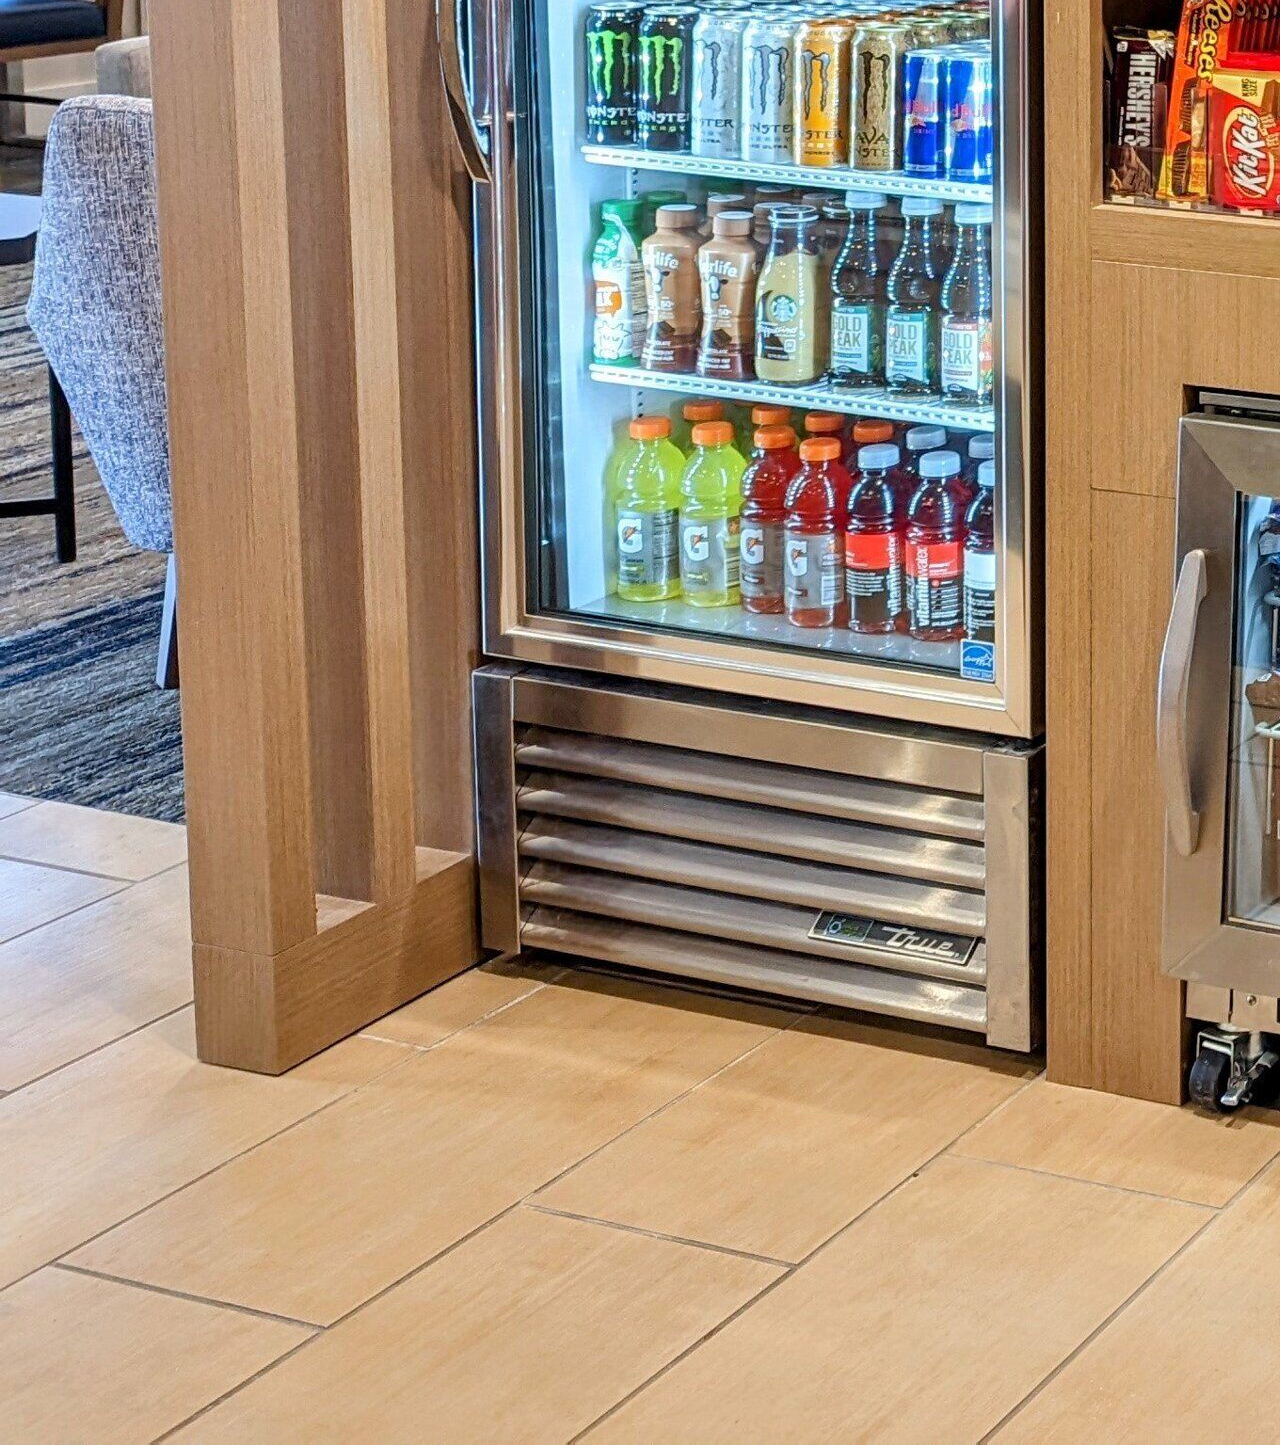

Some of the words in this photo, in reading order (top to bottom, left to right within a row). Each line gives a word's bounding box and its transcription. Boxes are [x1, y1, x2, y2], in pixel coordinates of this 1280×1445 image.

[1124, 53, 1157, 148] HERSHEY'S
[832, 314, 861, 332] GOLD
[617, 517, 642, 553] G
[684, 524, 709, 561] G
[740, 528, 765, 565] G
[785, 539, 809, 576] G
[917, 546, 930, 628] vitaminwater
